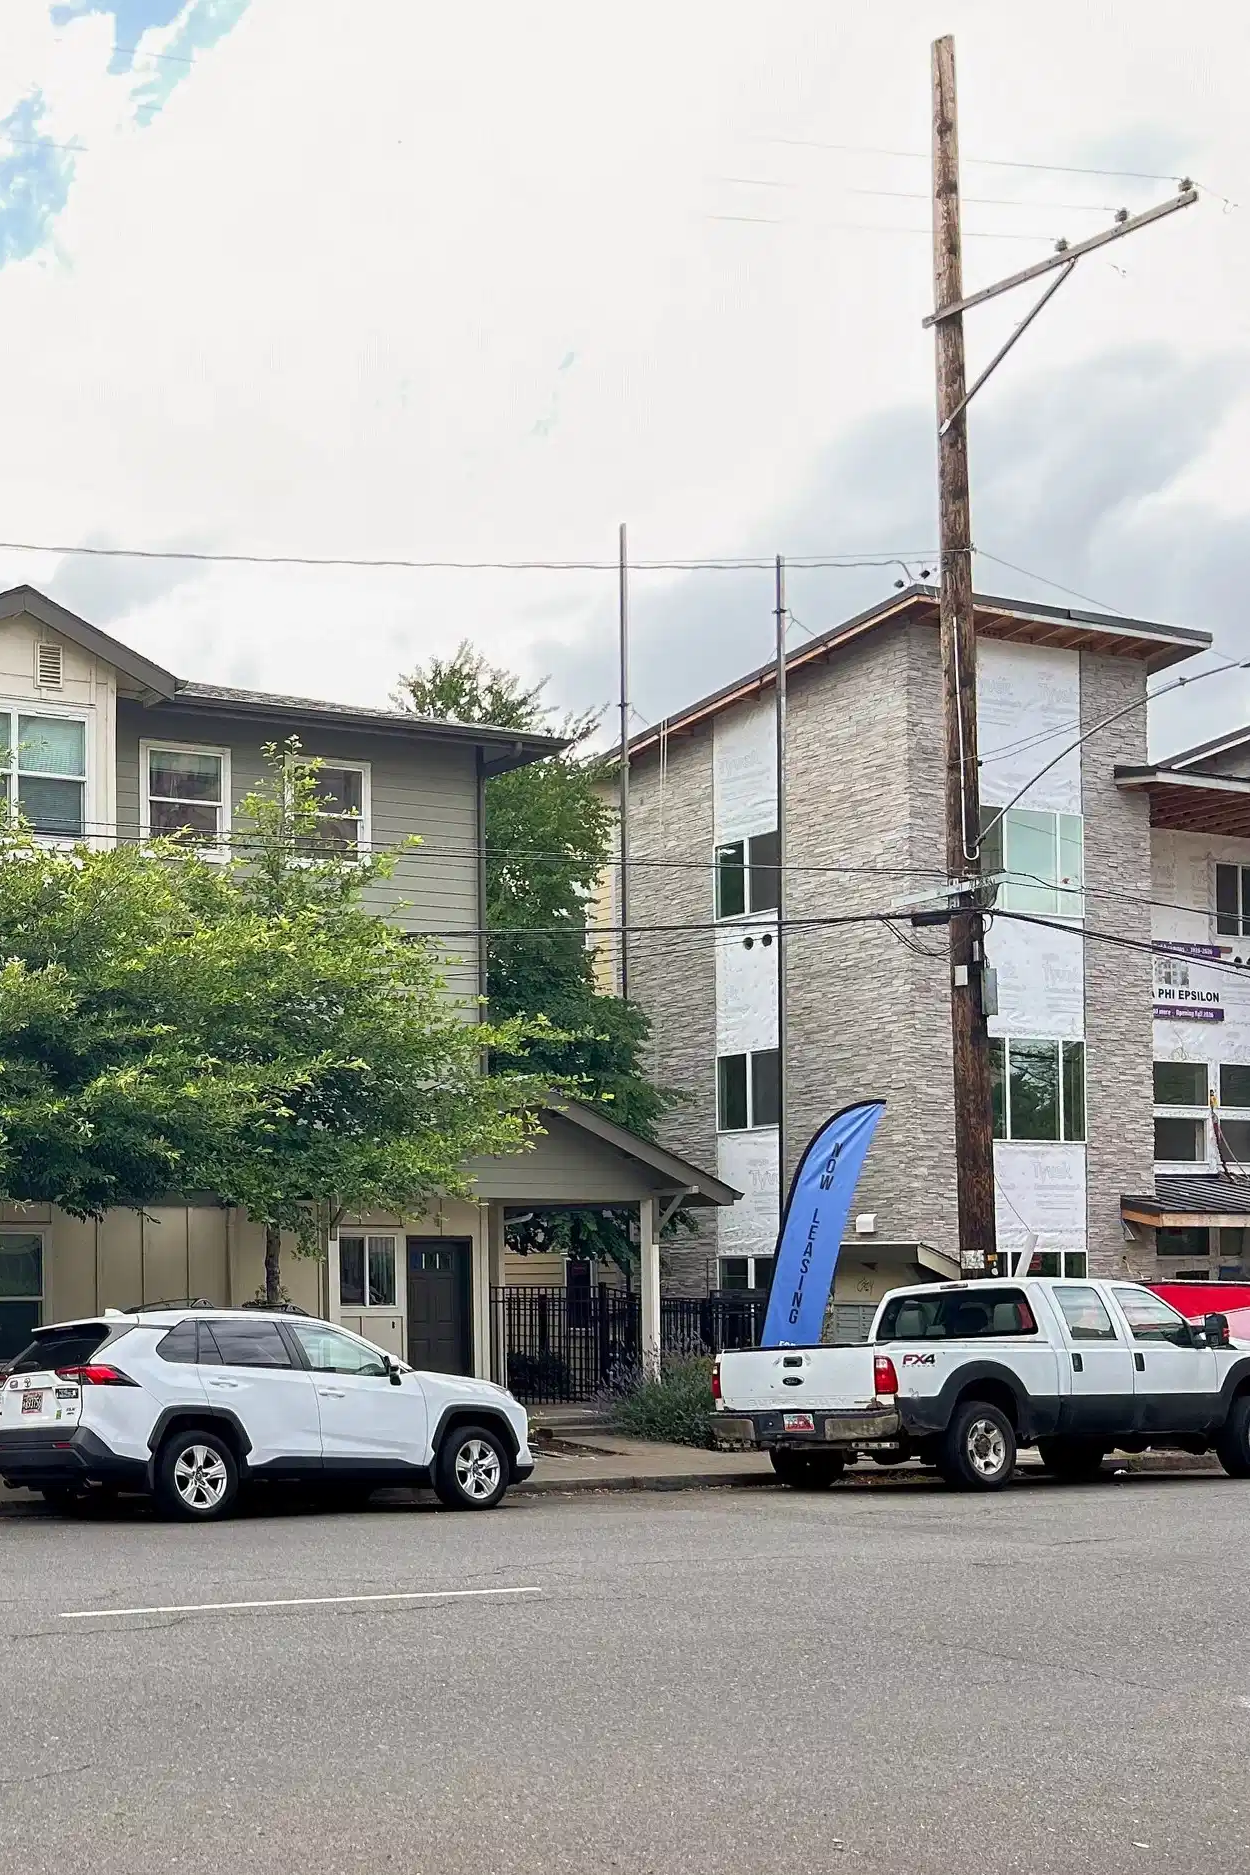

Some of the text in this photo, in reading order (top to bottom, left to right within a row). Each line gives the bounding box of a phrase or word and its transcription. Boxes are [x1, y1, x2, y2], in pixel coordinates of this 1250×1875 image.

[1158, 988, 1175, 999] PHI
[1178, 990, 1219, 1002] EPSILON
[1176, 1009, 1194, 1017] Opening
[819, 1142, 844, 1191] NOW
[788, 1208, 820, 1325] LEASING
[902, 1353, 935, 1365] FX4
